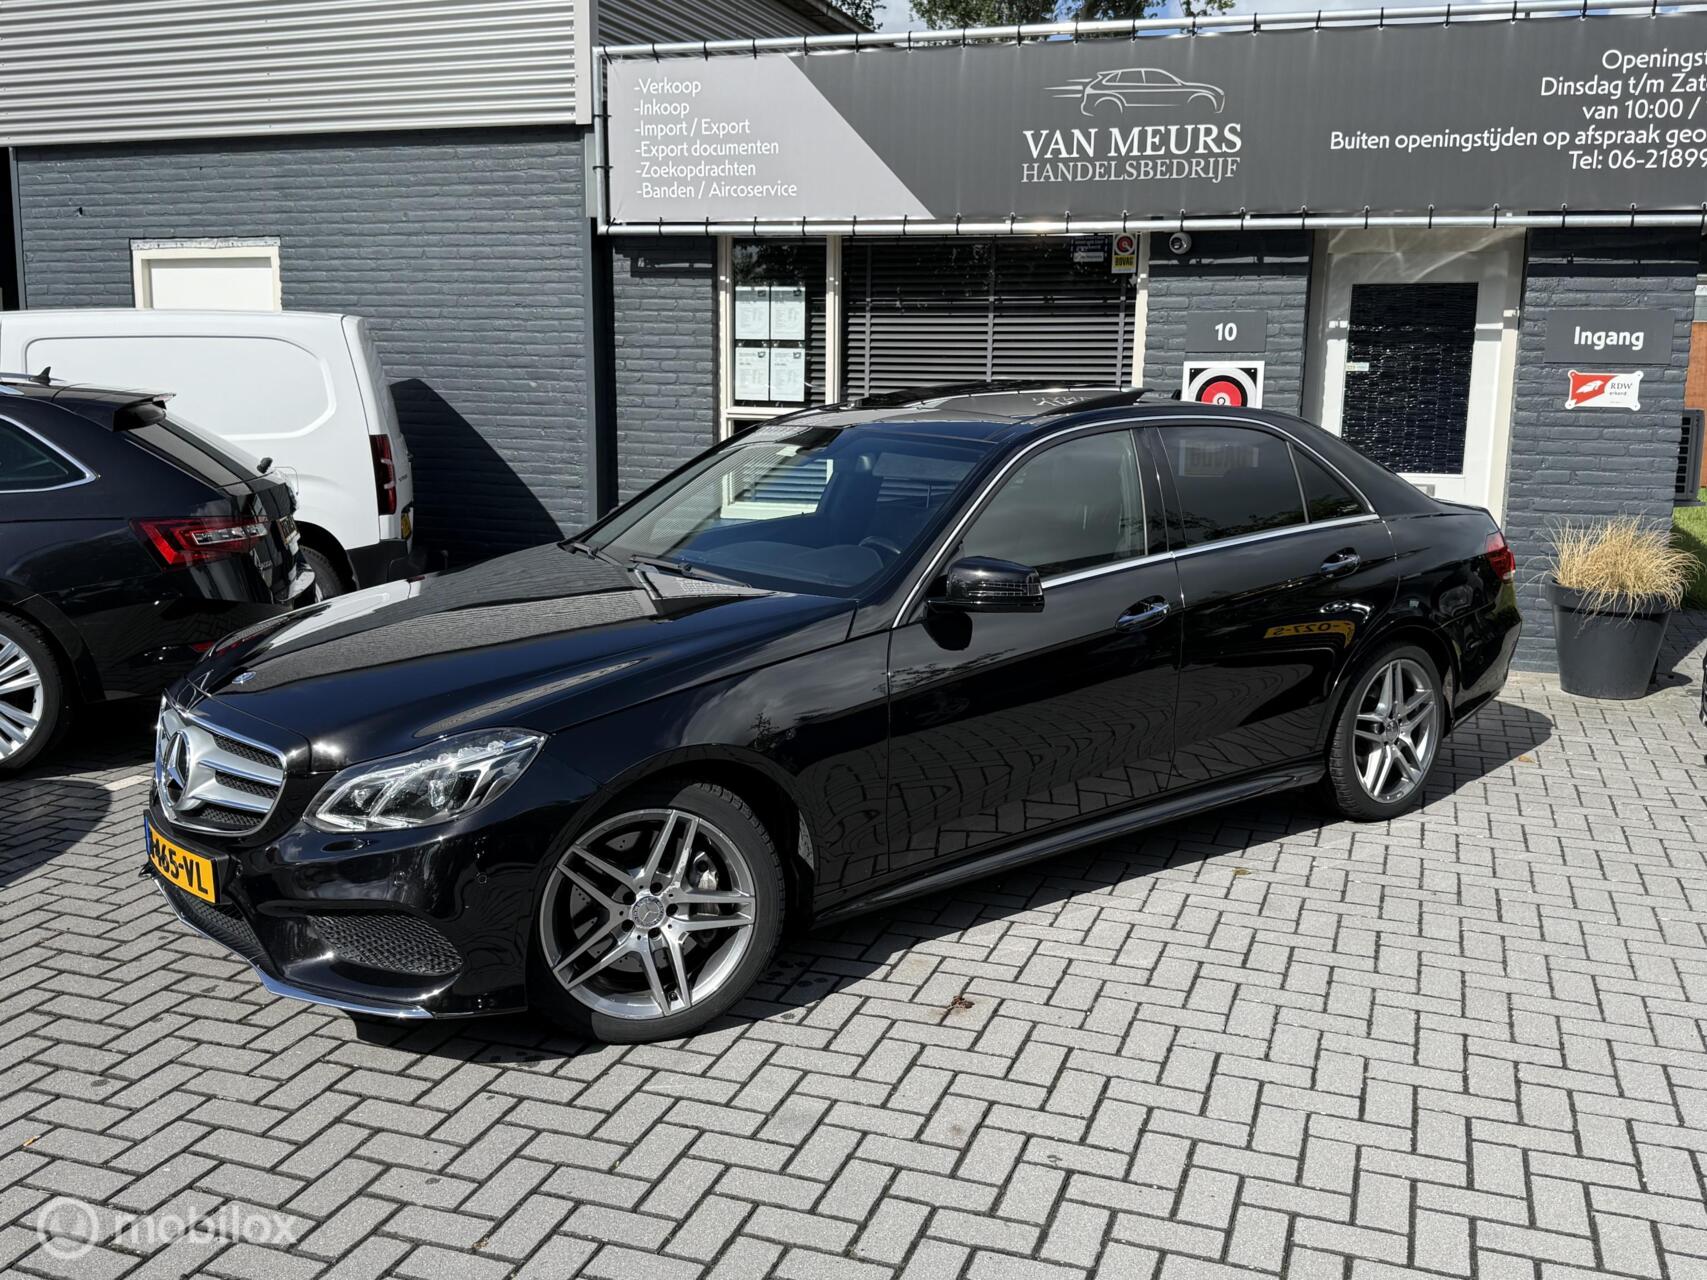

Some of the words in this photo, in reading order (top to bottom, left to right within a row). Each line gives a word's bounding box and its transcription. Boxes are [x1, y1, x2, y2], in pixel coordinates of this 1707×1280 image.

[633, 76, 702, 97] -Verkoop
[1540, 74, 1622, 99] Dinsdag
[1628, 72, 1664, 96] t/m
[1671, 73, 1707, 92] Zat
[633, 98, 690, 118] -Inkoop
[1582, 105, 1618, 119] van
[1625, 98, 1683, 119] 10:00
[1688, 96, 1701, 120] /
[634, 119, 688, 140] -Import
[690, 118, 698, 136] /
[701, 119, 751, 138] Export
[1330, 131, 1390, 150] Buiten
[1395, 126, 1537, 153] openingstijden
[1543, 131, 1570, 150] op
[1575, 124, 1661, 149] afspraak
[635, 140, 689, 160] -Export
[691, 139, 779, 156] documenten
[1022, 128, 1099, 159] VAN
[1107, 122, 1242, 157] MEURS
[635, 160, 757, 180] -Zoekopdrachten
[1020, 157, 1241, 183] HANDELSBEDRIJF
[1569, 149, 1603, 170] Tel:
[1608, 148, 1707, 169] 06-21899
[636, 181, 695, 198] -Banden
[698, 180, 705, 199] /
[708, 180, 798, 198] Aircoservice
[1215, 322, 1238, 342] 10
[1574, 326, 1645, 351] Ingang
[1610, 382, 1633, 390] RDW
